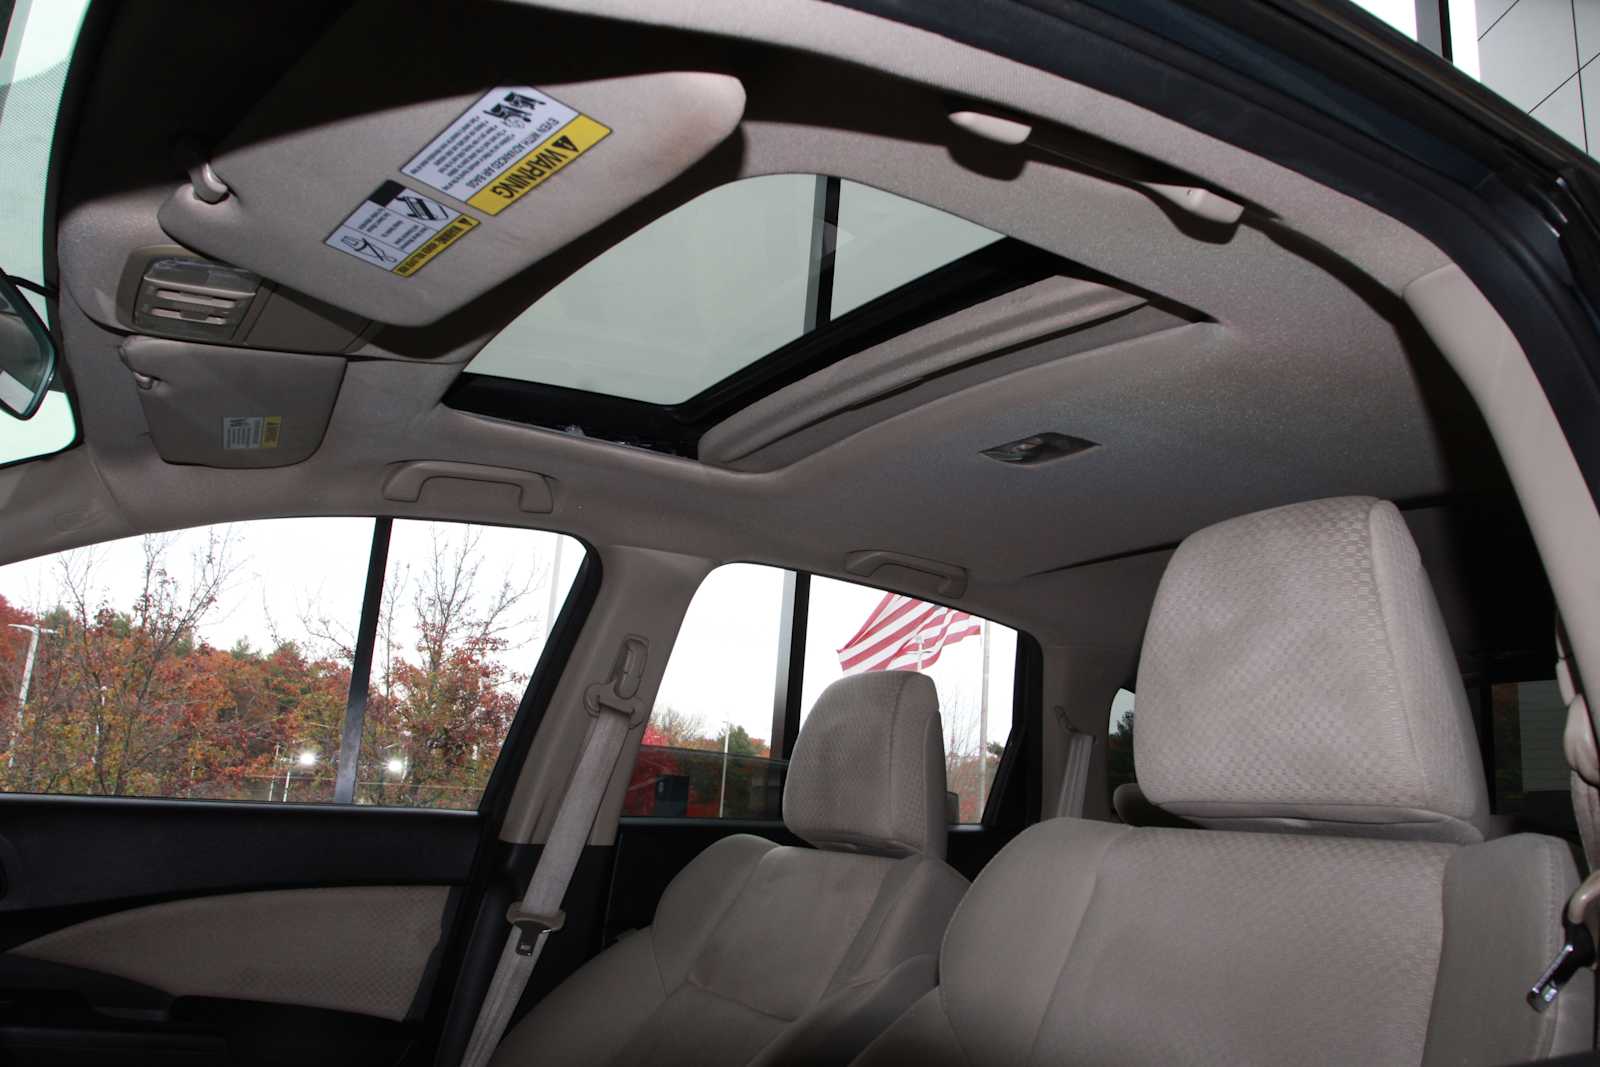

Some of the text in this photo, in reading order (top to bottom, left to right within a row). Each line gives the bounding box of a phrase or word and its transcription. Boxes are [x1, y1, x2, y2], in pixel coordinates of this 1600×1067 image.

[465, 118, 560, 189] EVEN WITH ADVANCED AIR BAGS
[492, 148, 568, 198] WARNING
